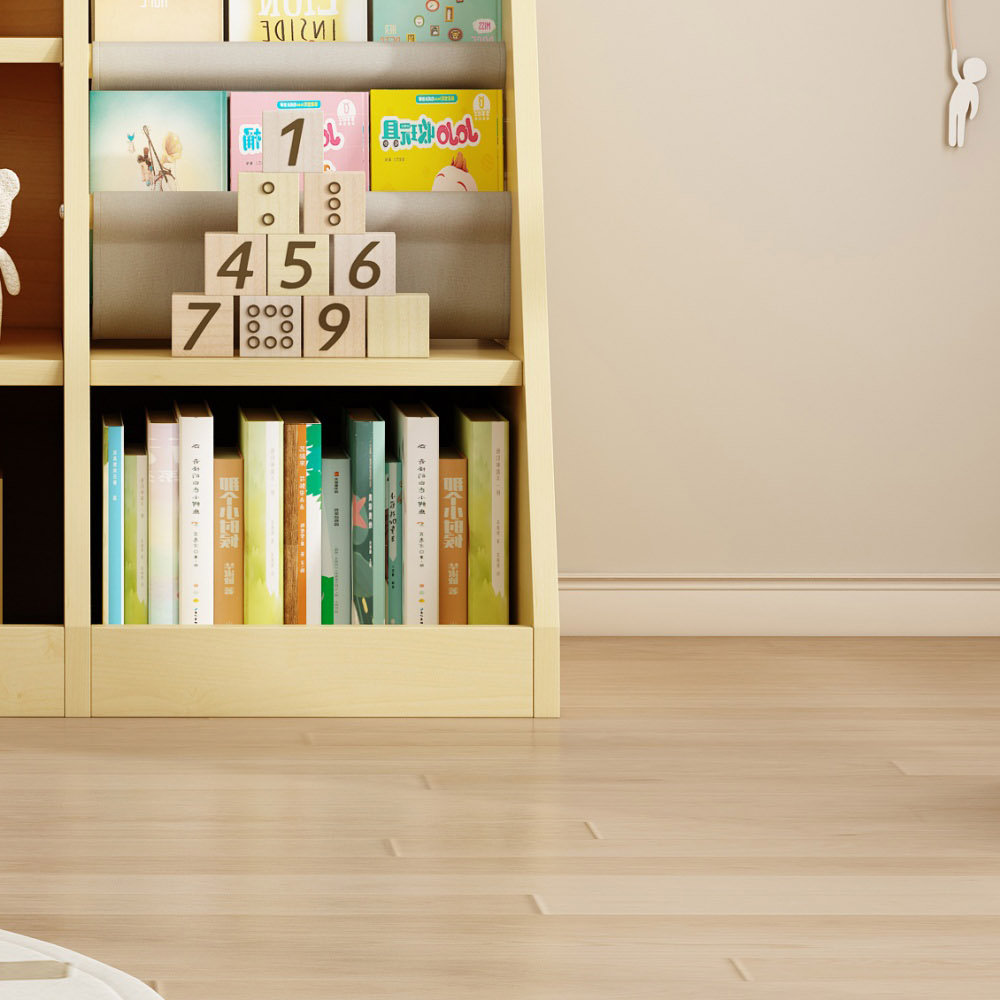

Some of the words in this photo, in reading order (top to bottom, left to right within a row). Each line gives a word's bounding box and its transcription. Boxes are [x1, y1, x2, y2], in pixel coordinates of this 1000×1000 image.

[280, 118, 305, 167] 1
[216, 241, 254, 289] 4
[280, 241, 316, 289] 5
[348, 241, 381, 289] 6
[183, 302, 221, 351] 7
[318, 302, 350, 351] 9
